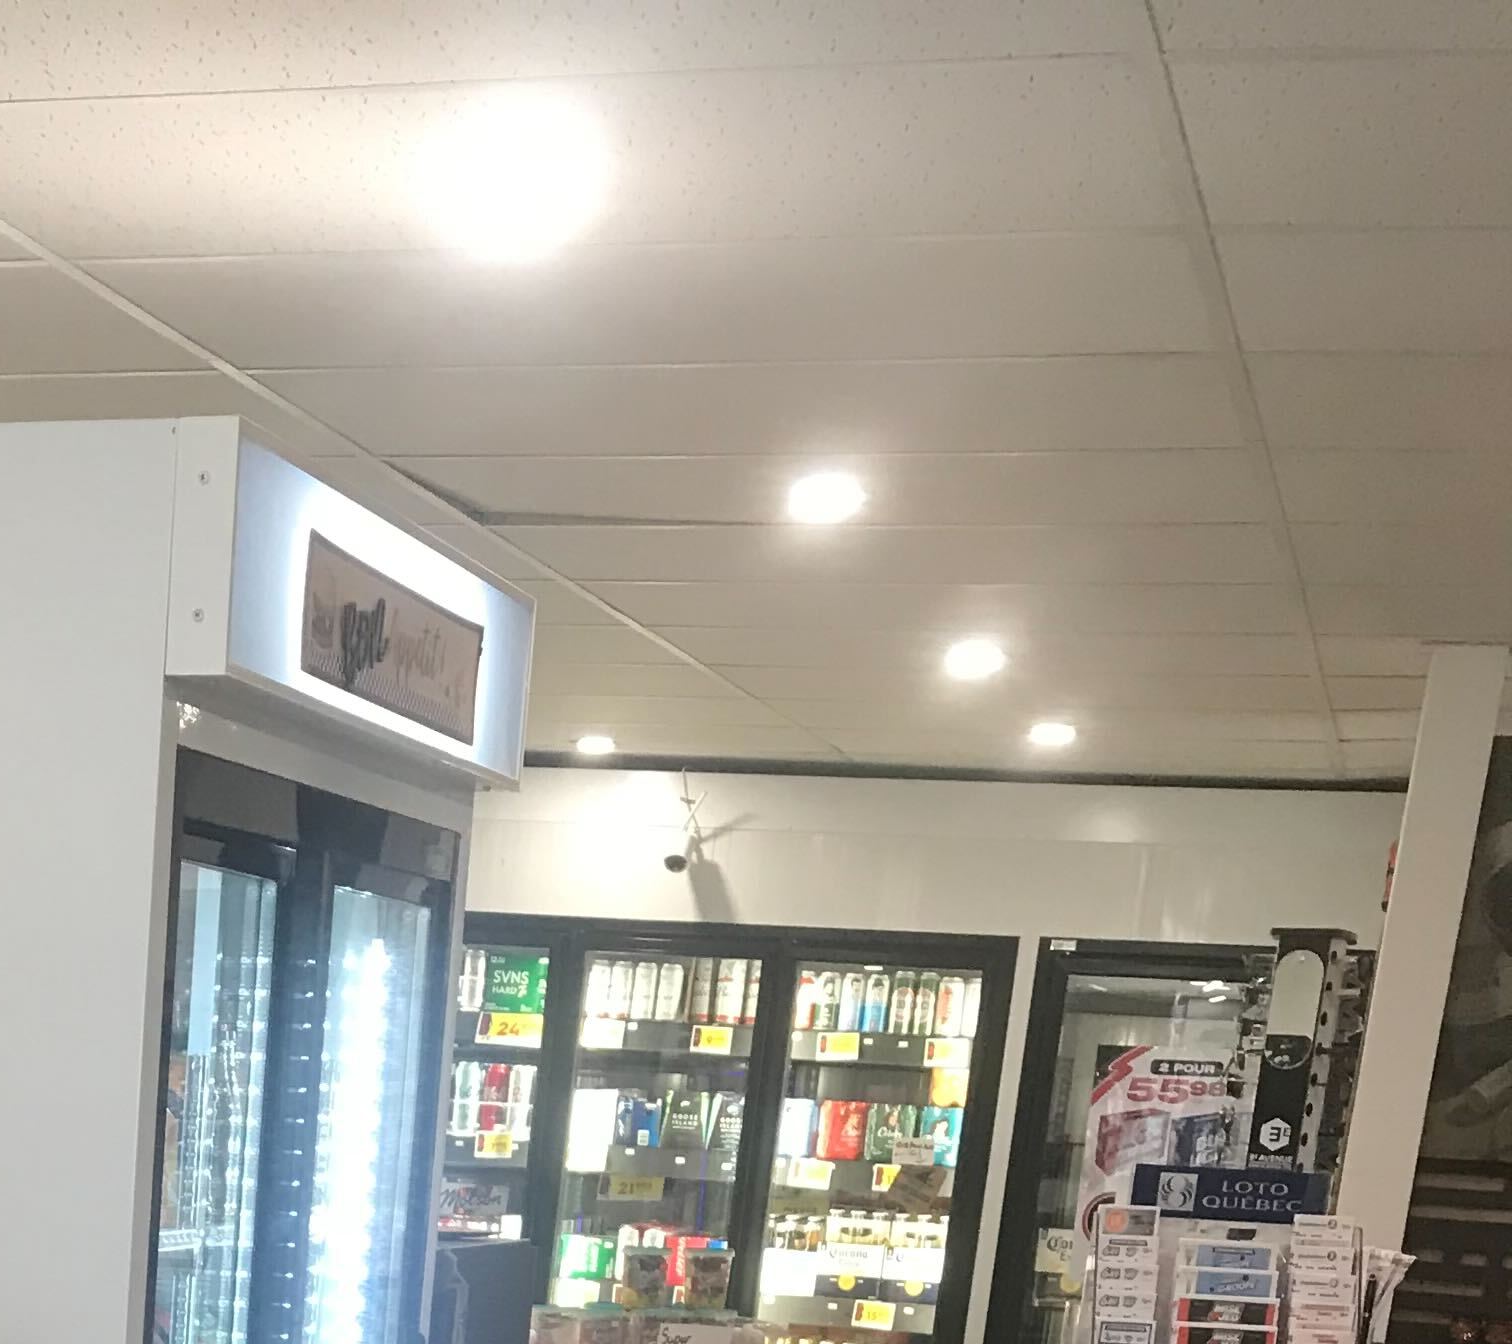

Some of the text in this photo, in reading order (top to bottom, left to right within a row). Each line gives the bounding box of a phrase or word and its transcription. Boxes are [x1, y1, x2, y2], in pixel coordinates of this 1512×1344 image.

[493, 969, 530, 985] SVNS
[1157, 1061, 1216, 1074] 2 POUR
[1221, 1179, 1289, 1196] LOTO
